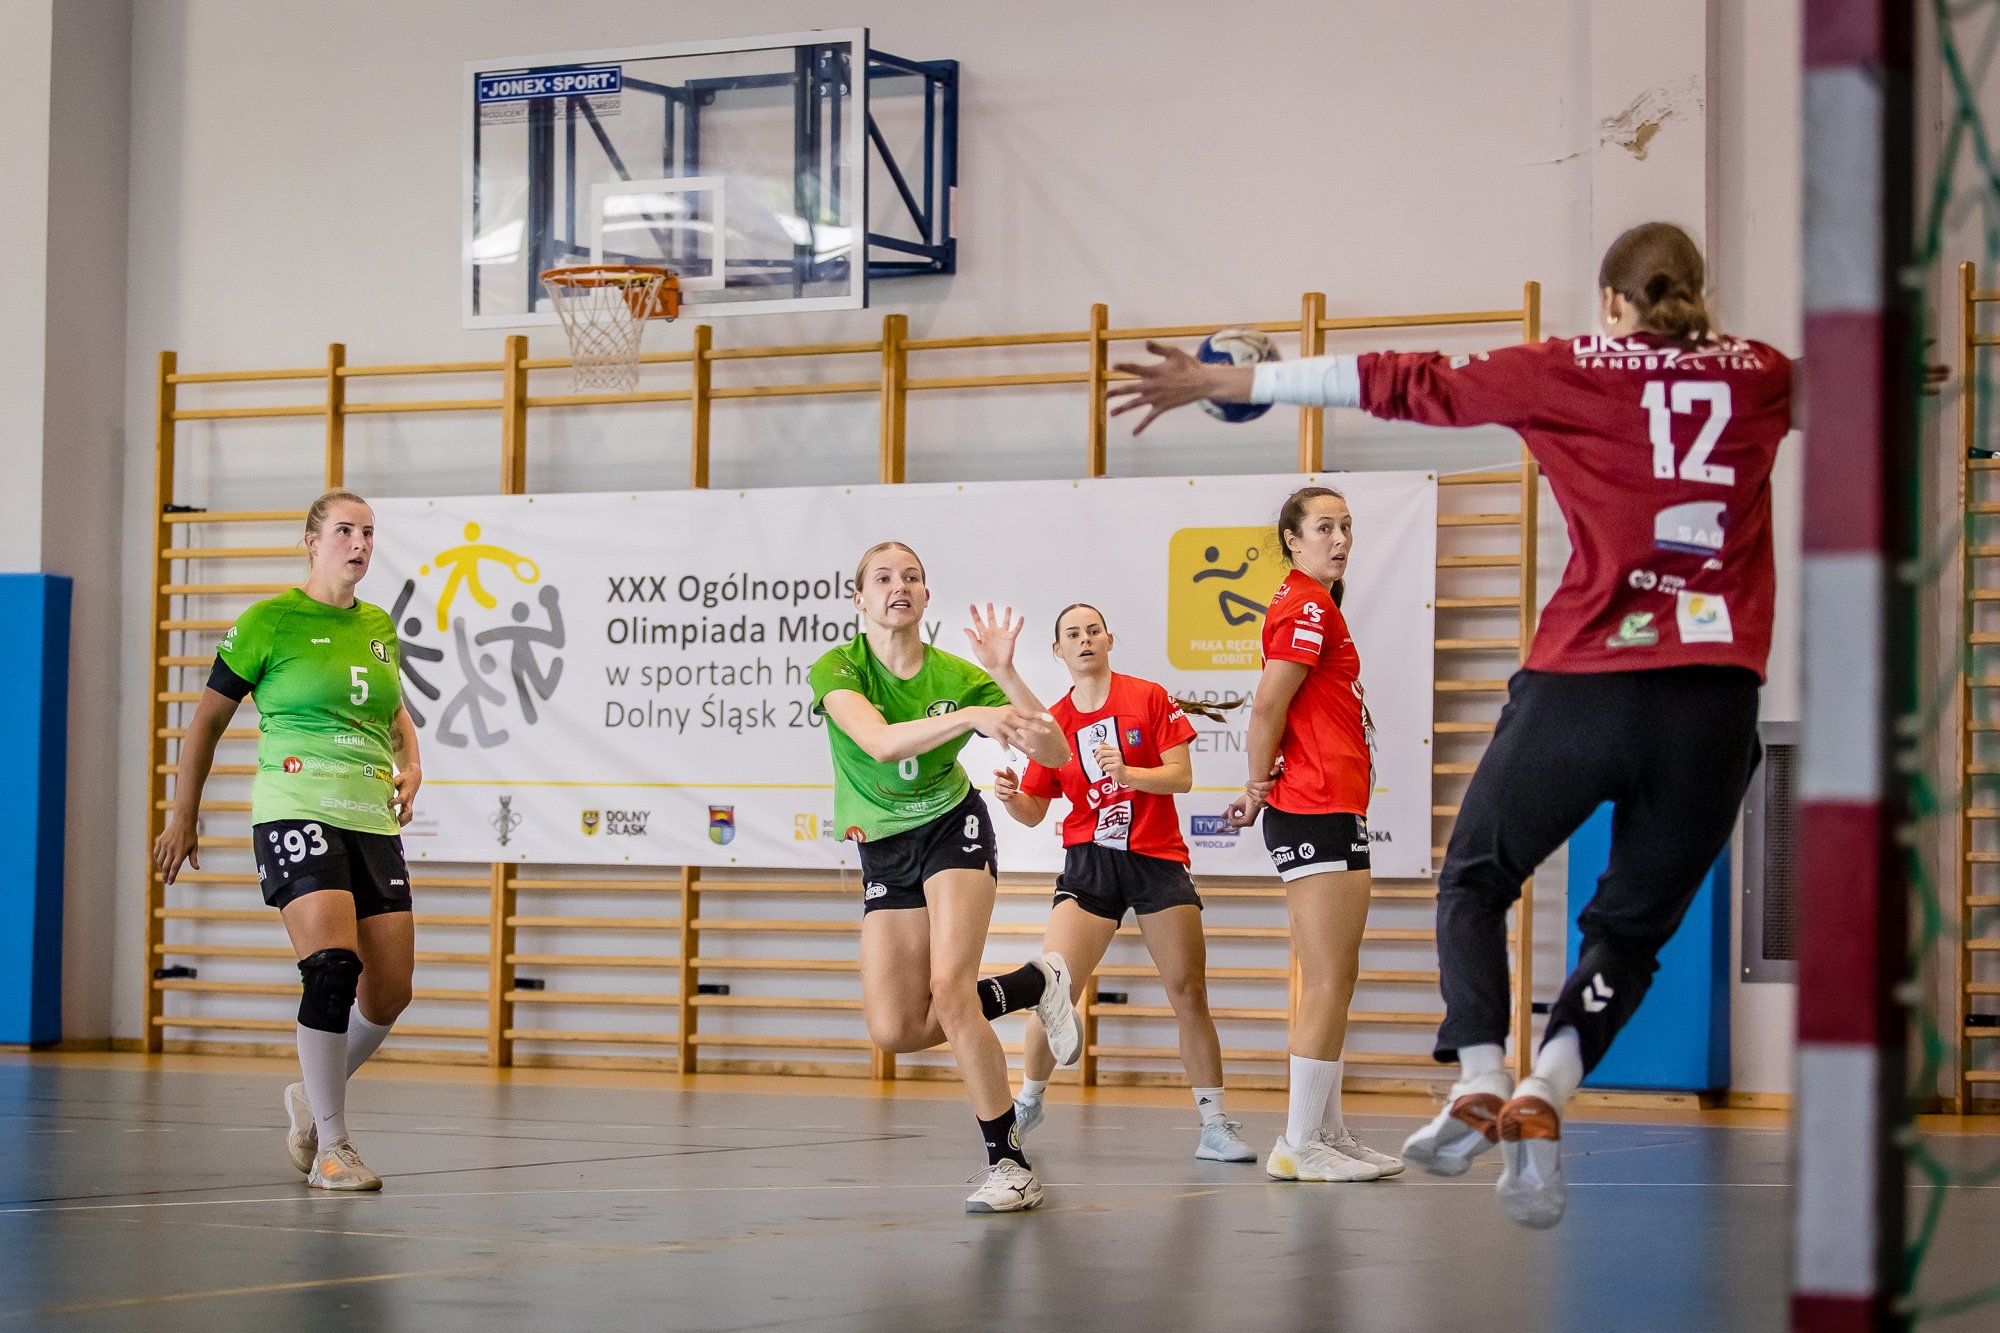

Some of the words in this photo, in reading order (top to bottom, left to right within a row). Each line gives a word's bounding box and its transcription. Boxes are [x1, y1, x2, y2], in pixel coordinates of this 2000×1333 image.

[488, 78, 547, 97] JONEX
[552, 73, 610, 92] SPORT
[1640, 381, 1735, 486] 12
[607, 575, 667, 603] XXX
[678, 571, 856, 608] Ogólnopols
[607, 615, 766, 650] Olimpiada
[779, 613, 941, 646] Młody
[1190, 639, 1224, 651] PIŁKA
[1227, 639, 1262, 653] RĘCZN
[1211, 653, 1254, 664] KOBIET
[350, 666, 369, 706] 5
[606, 666, 630, 686] w
[641, 657, 772, 693] sportach
[605, 699, 691, 735] Dolny
[701, 693, 777, 735] Śląsk
[788, 700, 824, 728] 20
[606, 810, 651, 823] DOLNY
[606, 822, 648, 837] ŚLĄSK
[963, 814, 980, 840] 8
[284, 823, 329, 863] 93
[1195, 840, 1237, 849] WROCŁAW
[1351, 842, 1369, 853] Kemp
